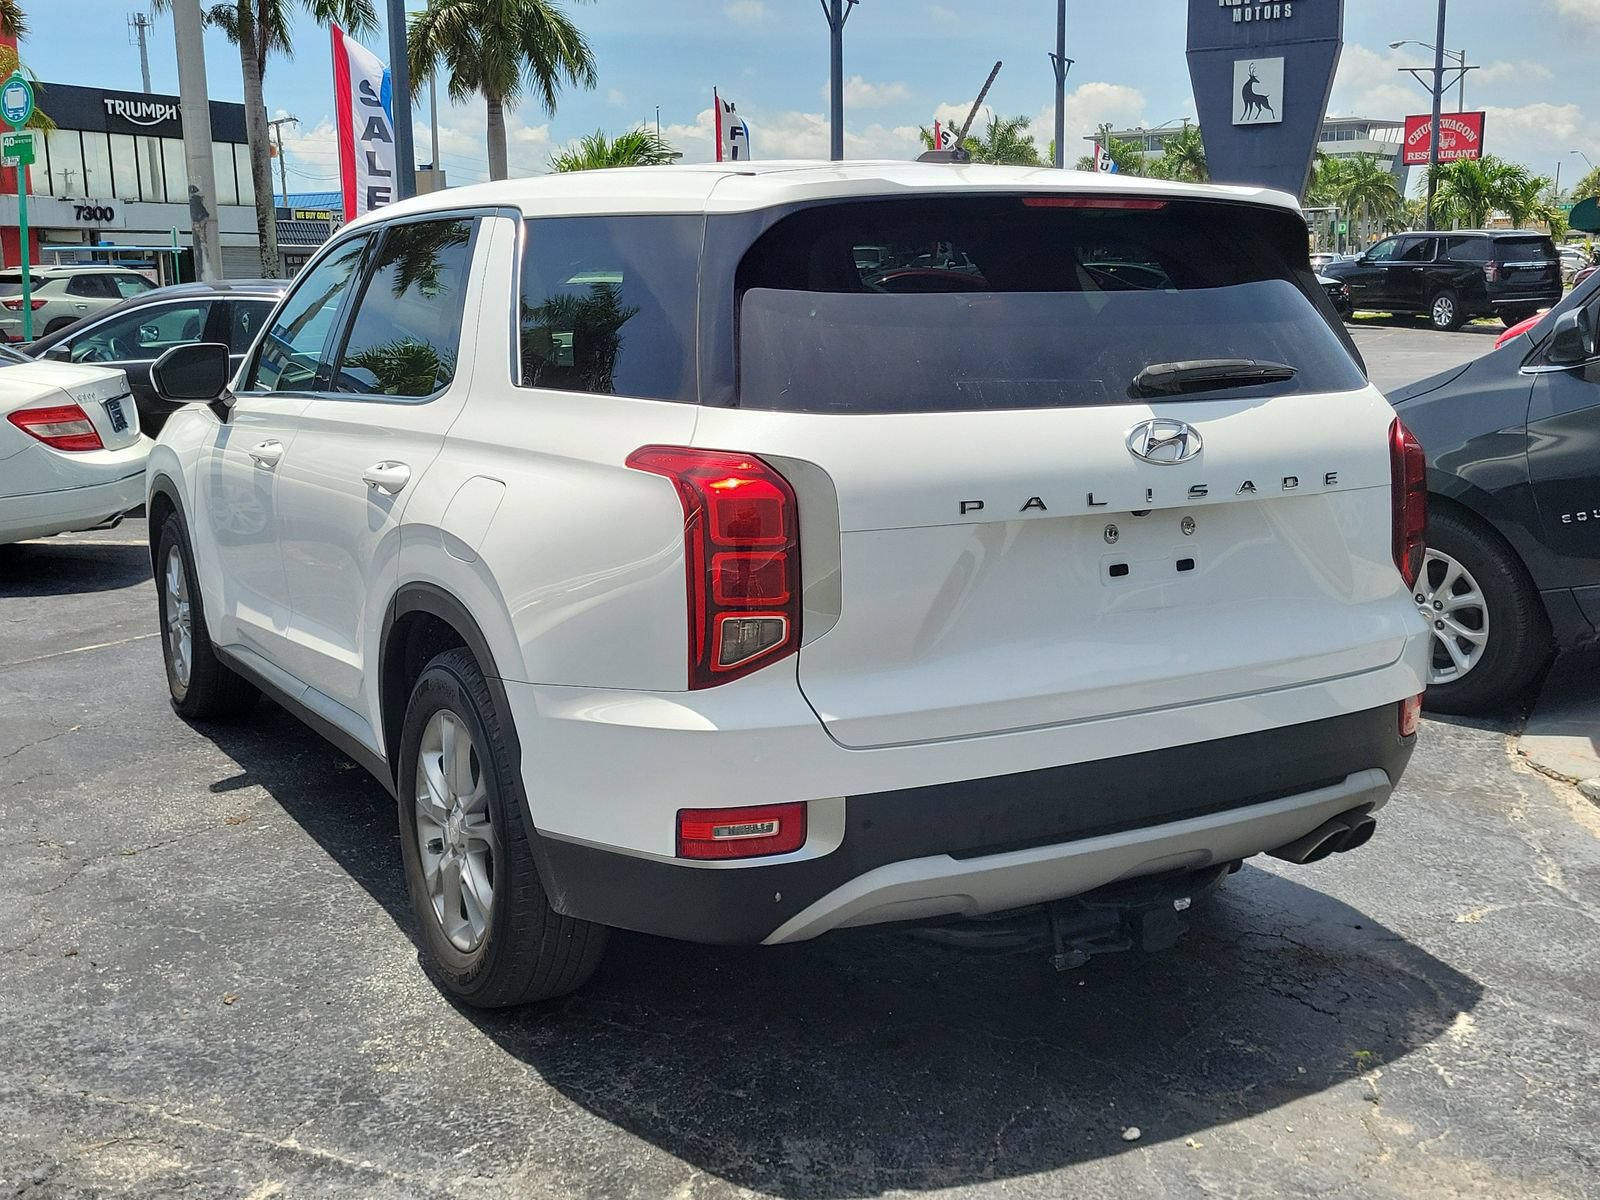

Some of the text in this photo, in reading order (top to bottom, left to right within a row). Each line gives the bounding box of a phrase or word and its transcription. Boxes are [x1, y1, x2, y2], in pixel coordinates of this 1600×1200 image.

[1232, 3, 1292, 22] MOTORS
[104, 98, 177, 125] TRIUMPH
[4, 137, 15, 147] 40
[1407, 118, 1477, 146] CHUCWAGON
[359, 79, 393, 211] SALE
[73, 205, 115, 222] 7300
[296, 211, 330, 220] WE BUY GOLD
[958, 470, 1341, 516] PALISADE
